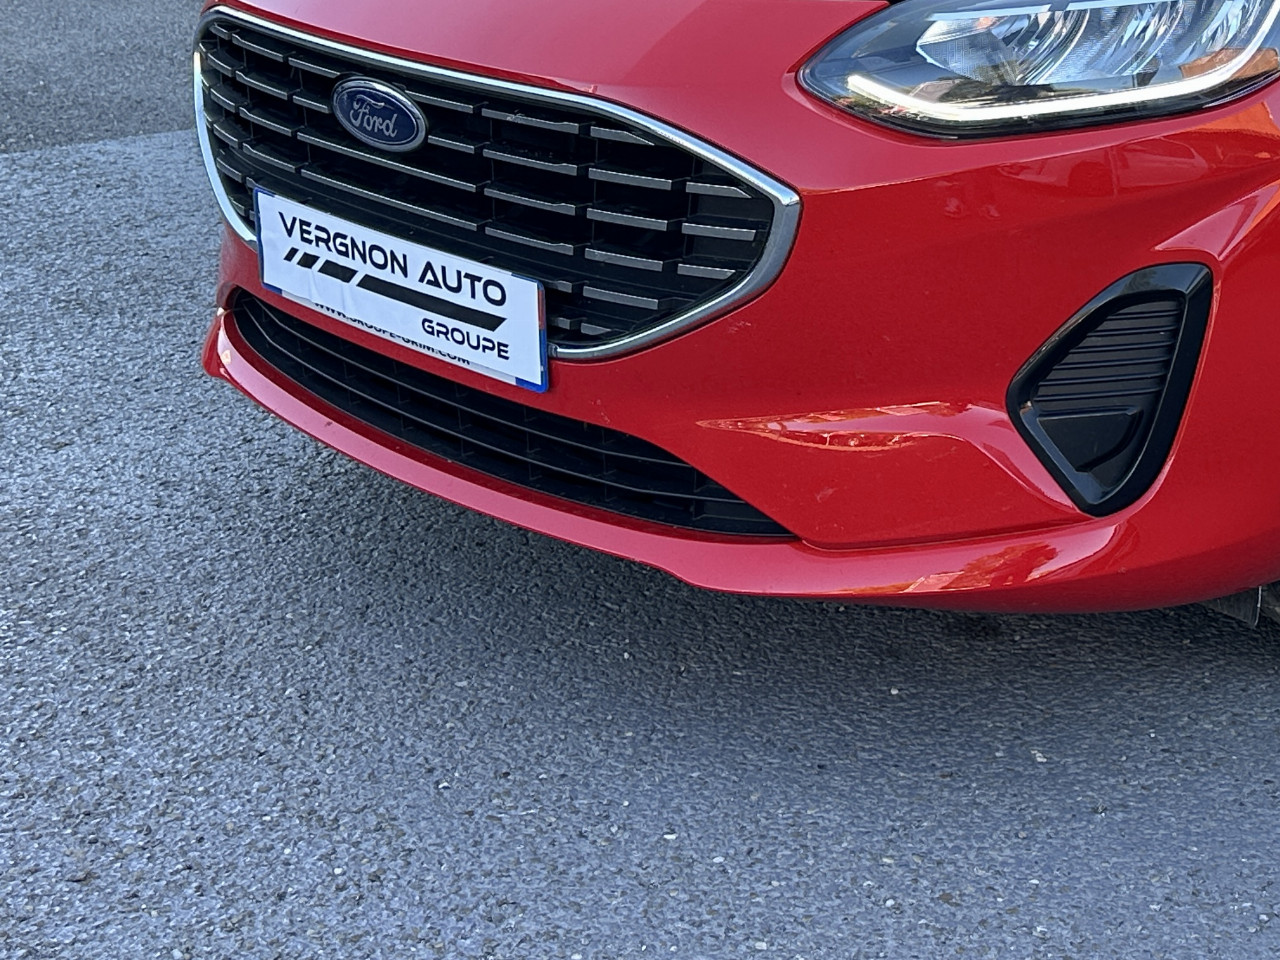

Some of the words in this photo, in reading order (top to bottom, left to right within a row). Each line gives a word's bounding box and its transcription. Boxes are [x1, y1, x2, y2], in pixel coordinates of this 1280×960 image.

[350, 94, 397, 138] Ford
[278, 211, 408, 278] VERGNON
[418, 260, 507, 306] AUTO
[421, 317, 510, 360] GROUPE
